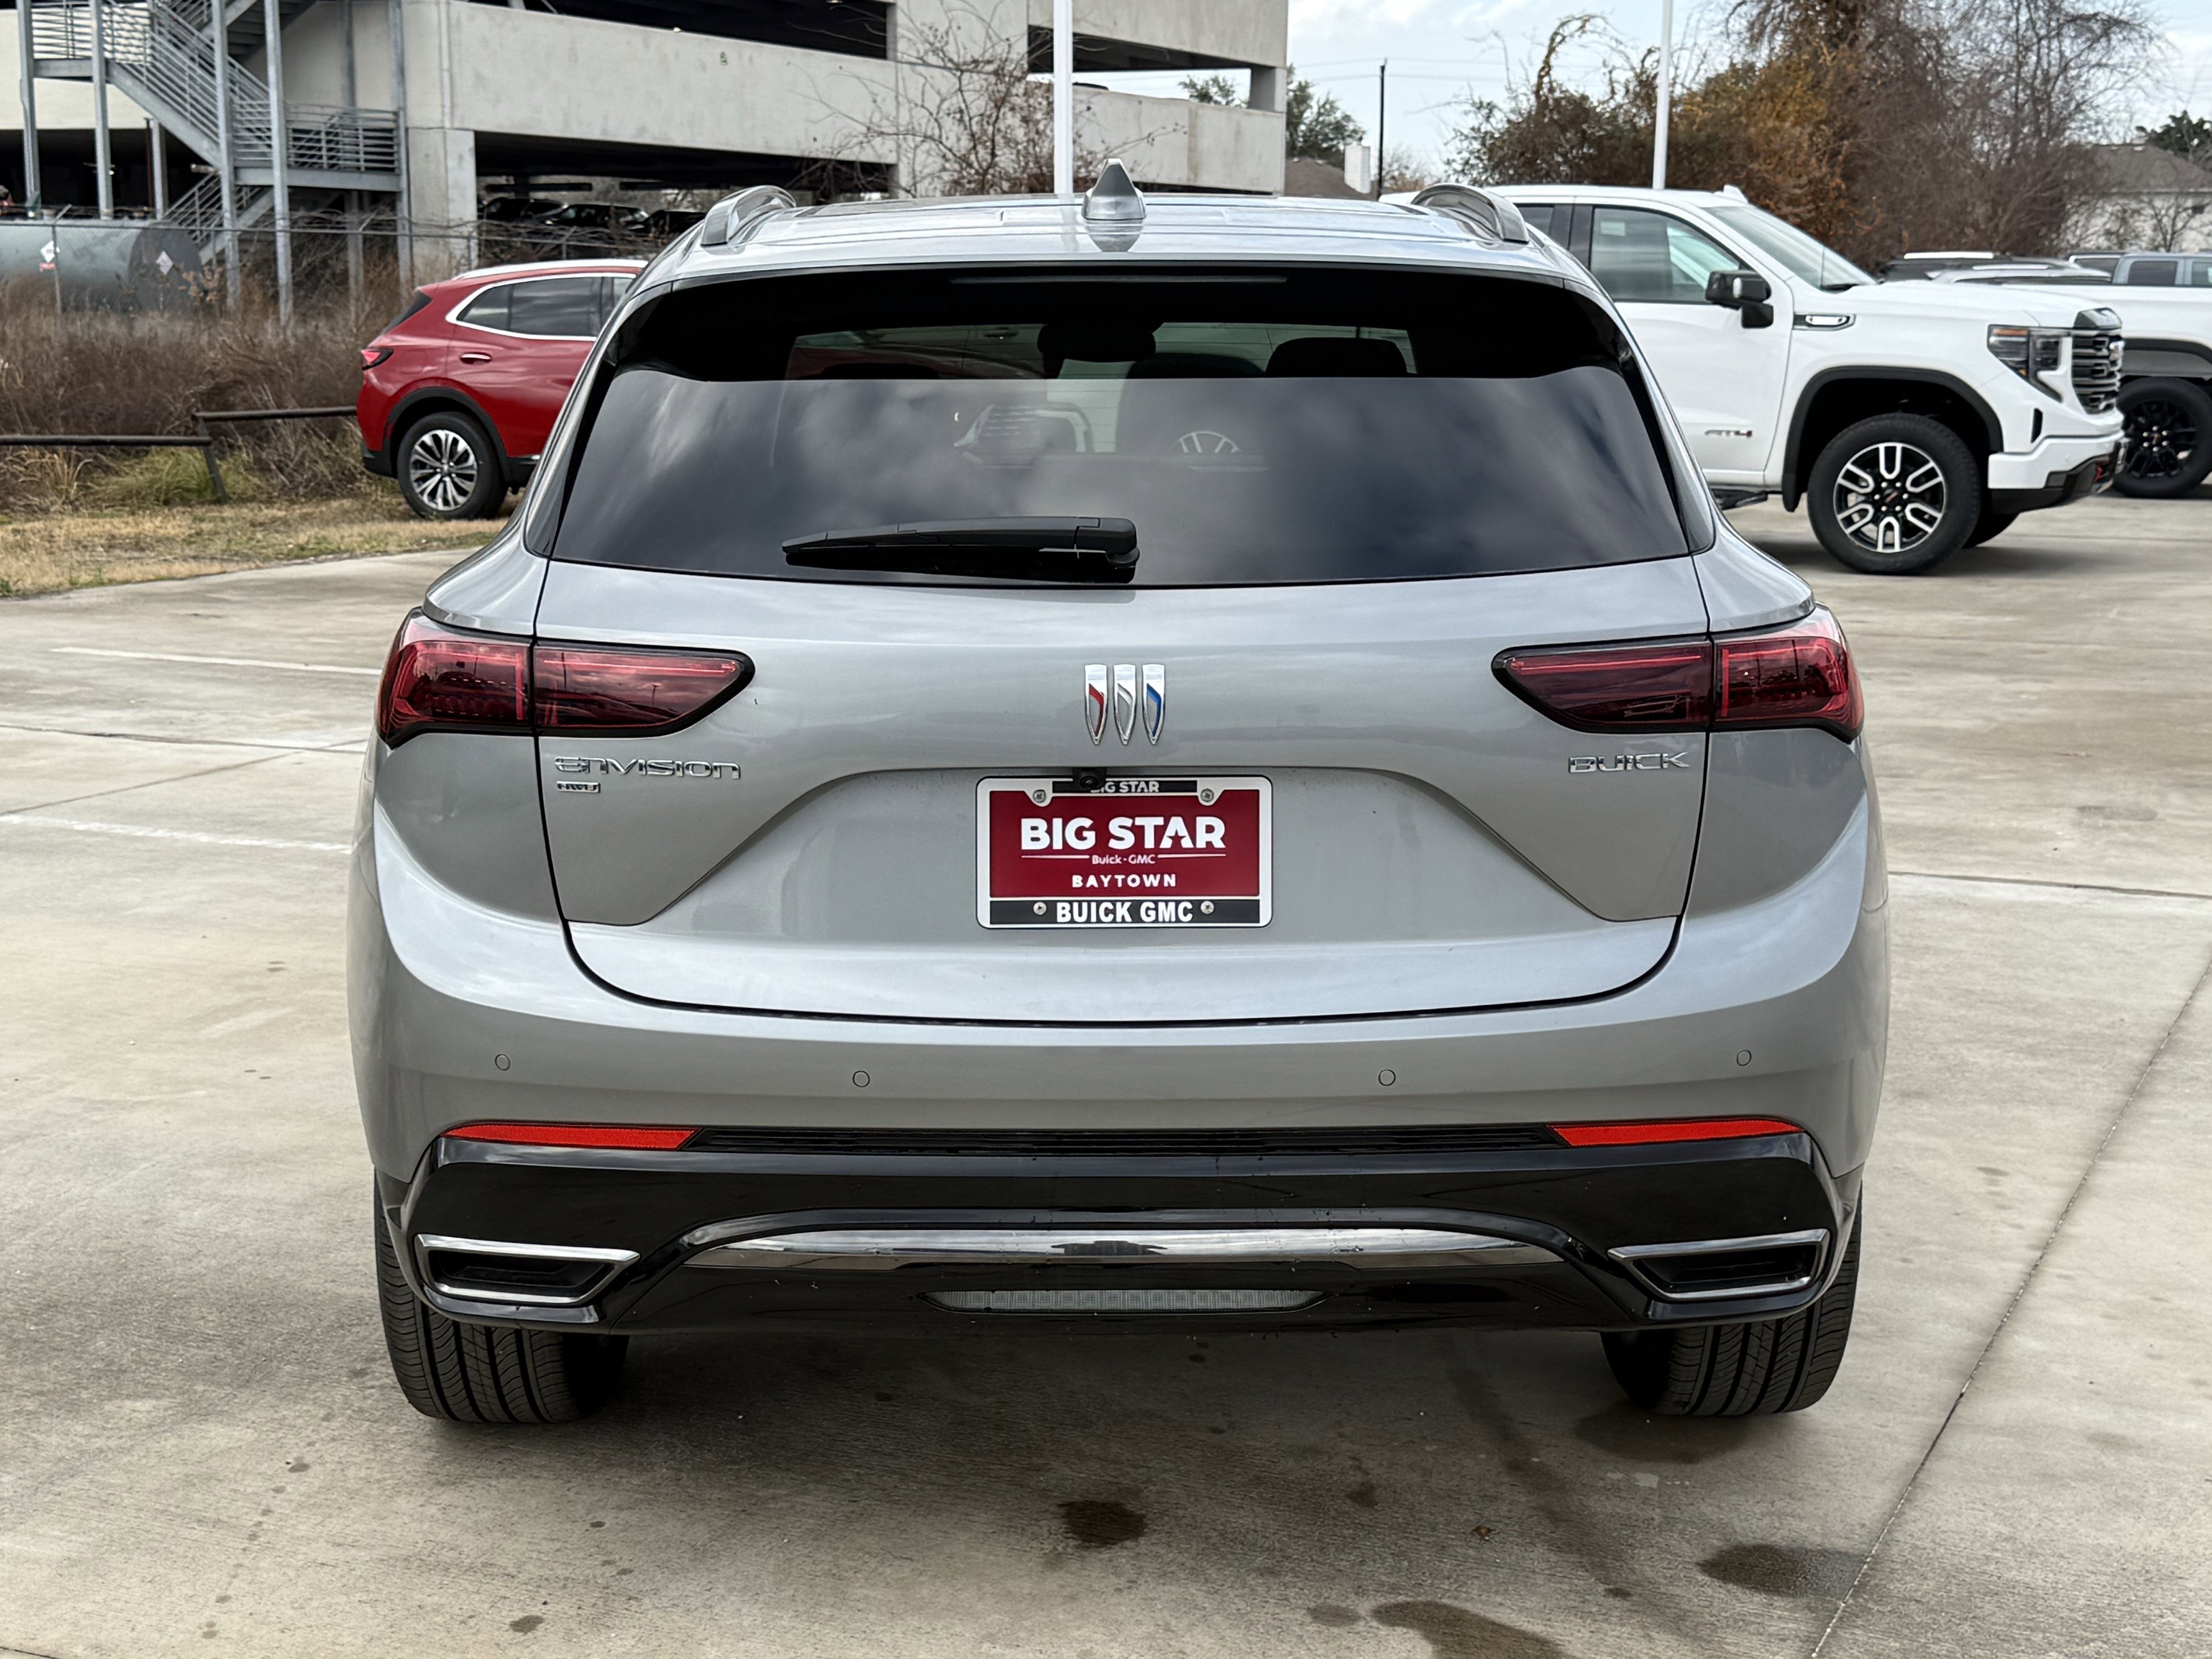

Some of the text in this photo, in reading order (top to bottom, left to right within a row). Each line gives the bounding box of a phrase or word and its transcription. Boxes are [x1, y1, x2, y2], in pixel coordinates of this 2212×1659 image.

[1568, 751, 1690, 773] BUICK
[1119, 781, 1159, 792] STAR
[1021, 816, 1226, 850] BIG STAR
[1072, 874, 1176, 888] BAYTOWN
[1056, 901, 1193, 922] BUICK GMC
